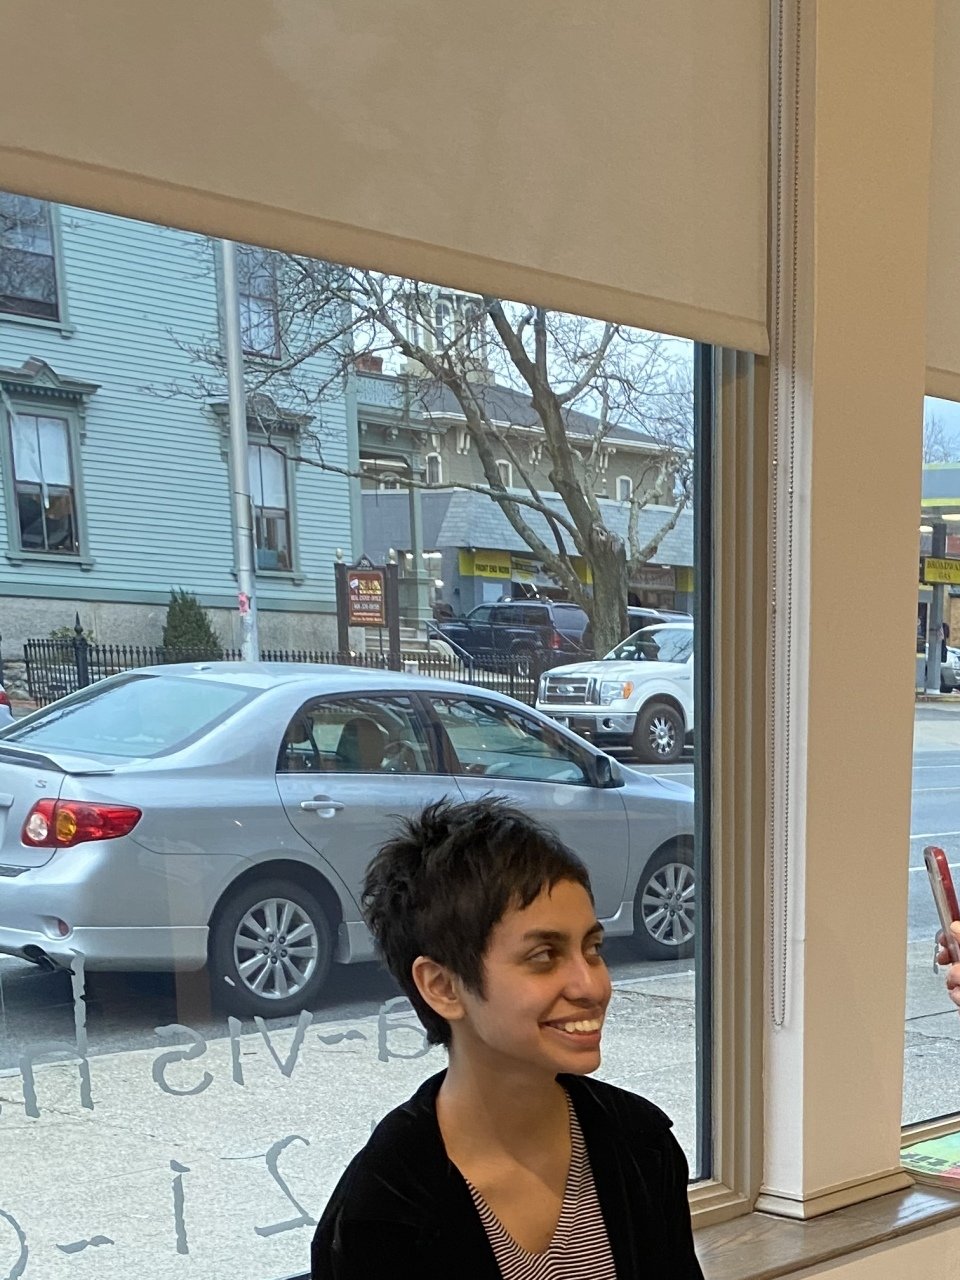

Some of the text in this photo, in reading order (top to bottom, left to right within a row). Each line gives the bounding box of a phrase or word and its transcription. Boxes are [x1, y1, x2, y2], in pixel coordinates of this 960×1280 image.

[475, 563, 489, 573] FRONT
[939, 572, 951, 580] GAS
[35, 778, 48, 790] S
